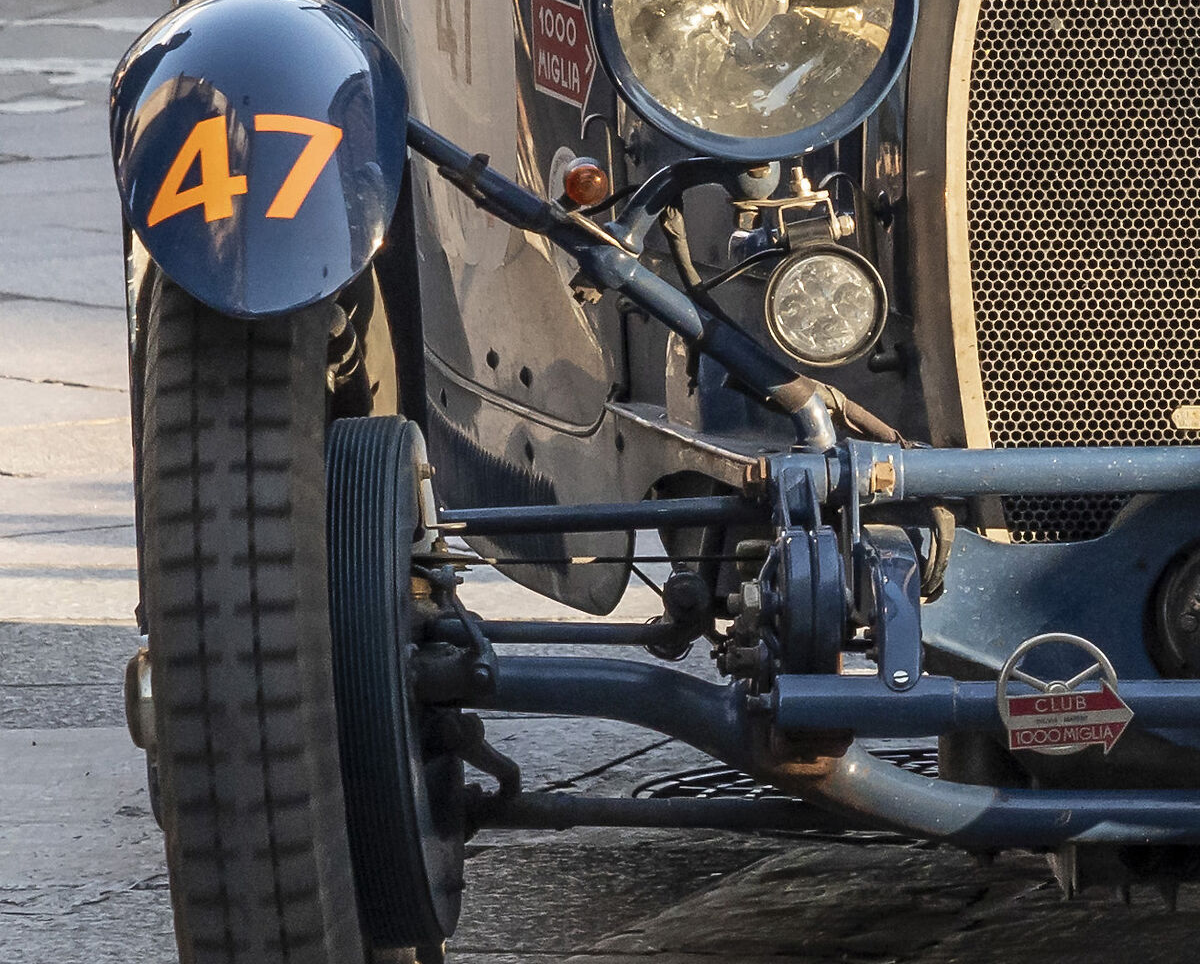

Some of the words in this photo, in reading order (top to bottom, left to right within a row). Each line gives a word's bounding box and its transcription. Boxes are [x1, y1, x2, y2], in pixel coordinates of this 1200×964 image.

[538, 6, 577, 46] 1000
[538, 48, 580, 94] MIGLIA
[147, 113, 343, 227] 47
[1035, 695, 1087, 713] CLUB
[1015, 729, 1061, 745] 1000
[1063, 726, 1114, 742] MIGLIA
